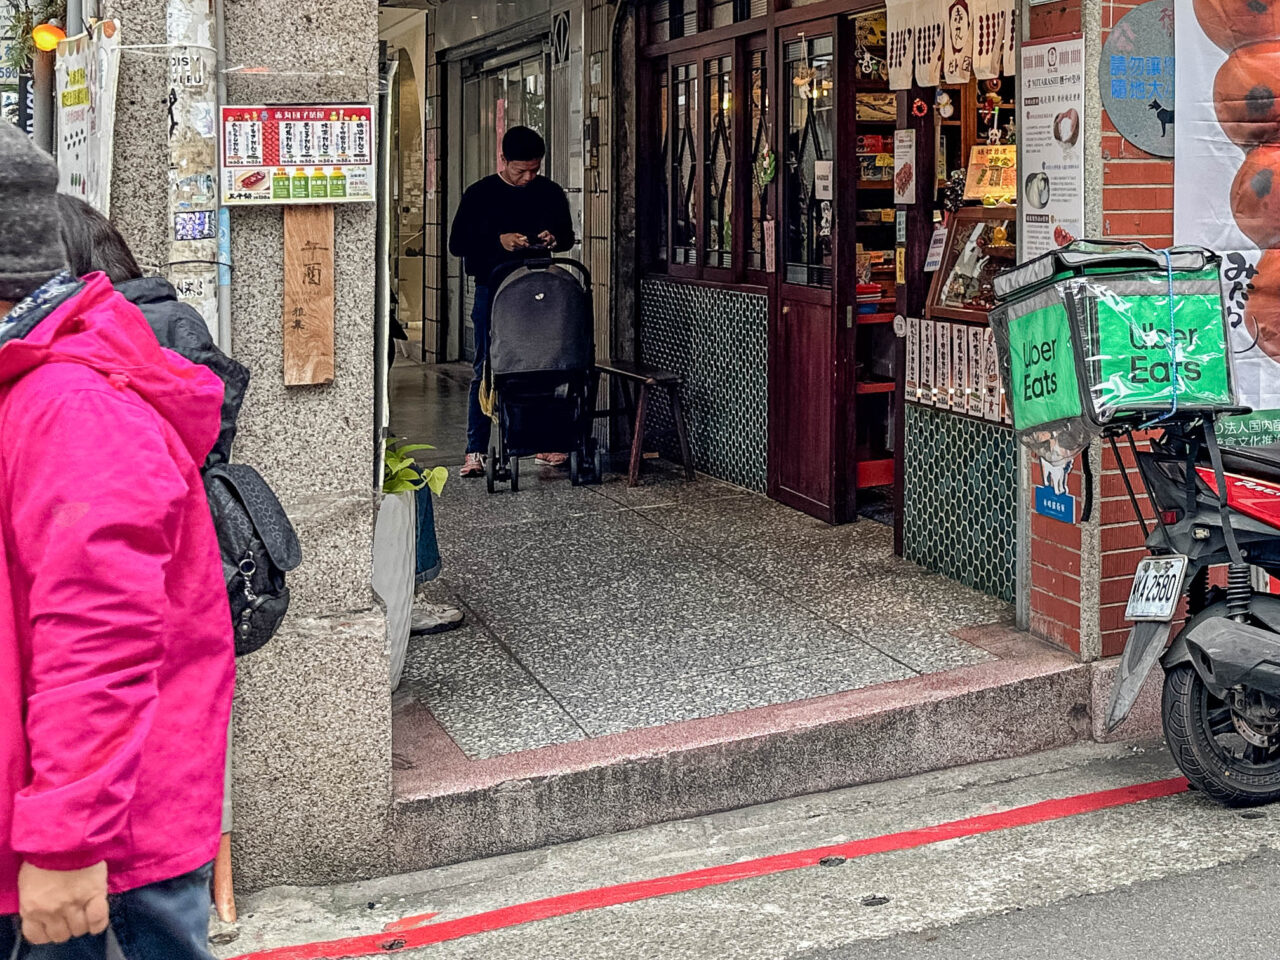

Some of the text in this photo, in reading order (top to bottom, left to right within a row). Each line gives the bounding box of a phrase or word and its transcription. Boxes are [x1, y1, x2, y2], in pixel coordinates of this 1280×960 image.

[1129, 322, 1199, 350] Uber
[1022, 337, 1058, 369] Uber
[1130, 355, 1202, 383] Eats
[1023, 370, 1058, 402] Eats
